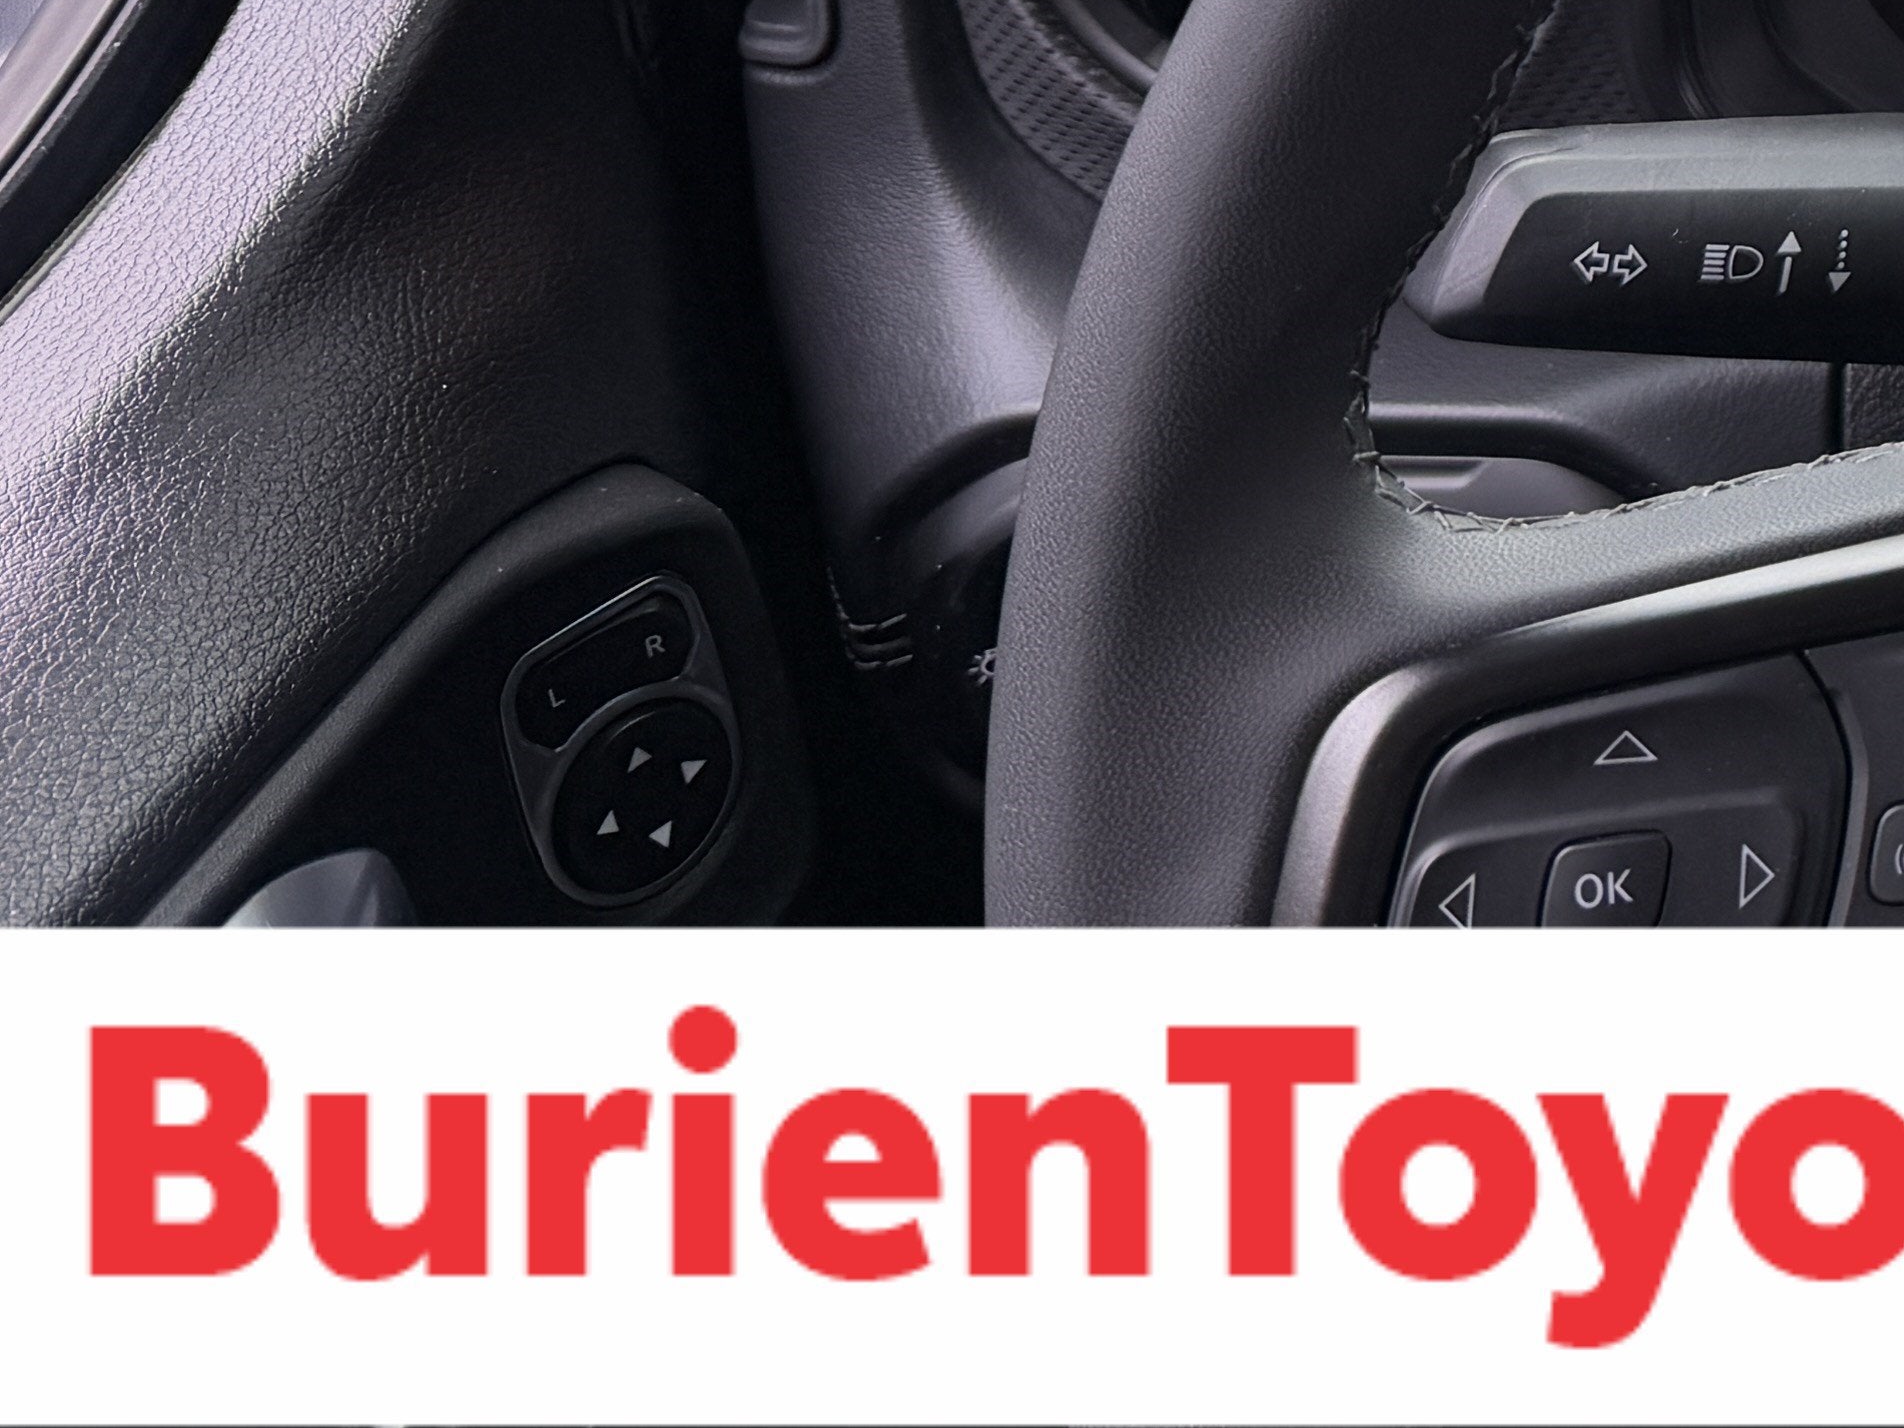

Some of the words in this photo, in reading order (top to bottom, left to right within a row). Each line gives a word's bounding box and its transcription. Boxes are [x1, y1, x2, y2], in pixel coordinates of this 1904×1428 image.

[645, 635, 666, 658] R
[547, 688, 565, 709] L
[1575, 869, 1634, 909] OK
